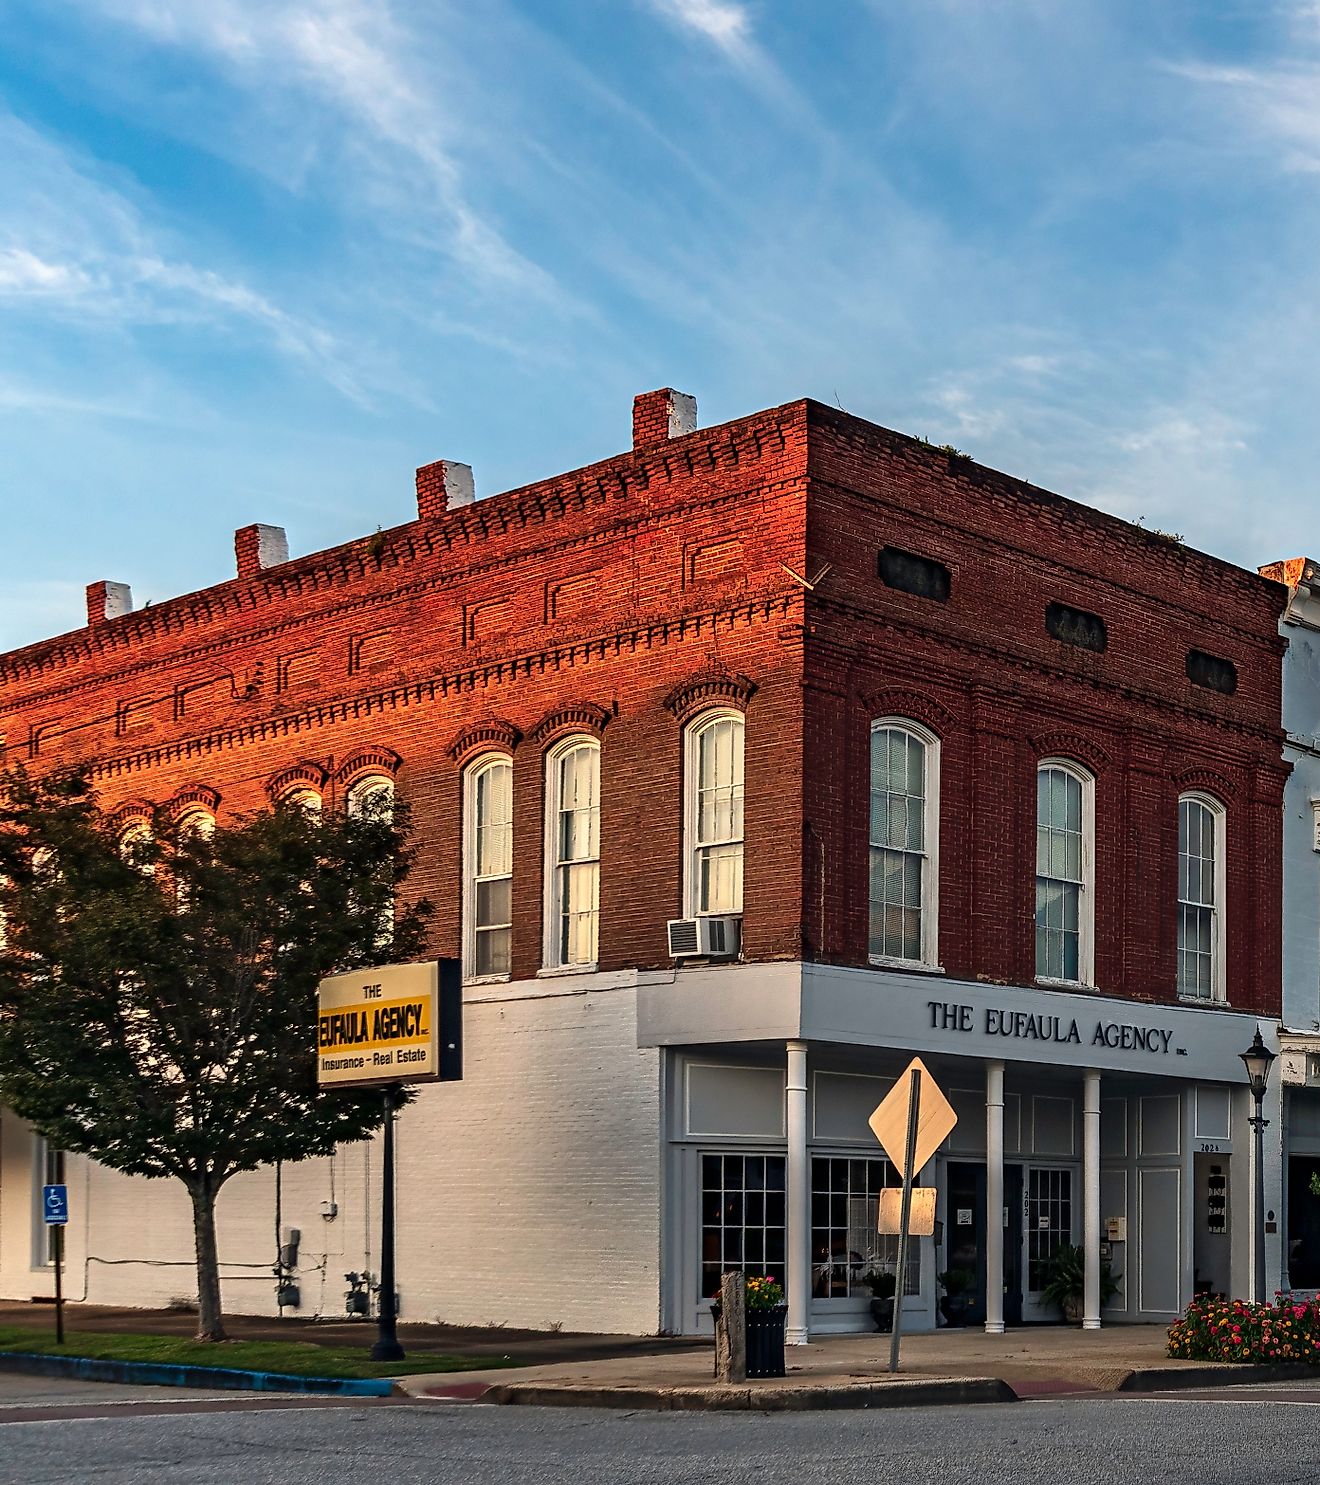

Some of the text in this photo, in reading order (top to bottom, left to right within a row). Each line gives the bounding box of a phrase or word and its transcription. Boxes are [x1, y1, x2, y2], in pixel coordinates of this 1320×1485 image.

[362, 984, 382, 999] THE
[319, 1010, 369, 1047] EUFAULA
[372, 1003, 423, 1041] AGENCY
[927, 1001, 974, 1032] THE
[984, 1008, 1082, 1044] EUFAULA
[1092, 1020, 1173, 1054] AGENCY
[321, 1056, 364, 1071] Insurance
[373, 1051, 393, 1066] Real
[397, 1048, 427, 1064] Estate
